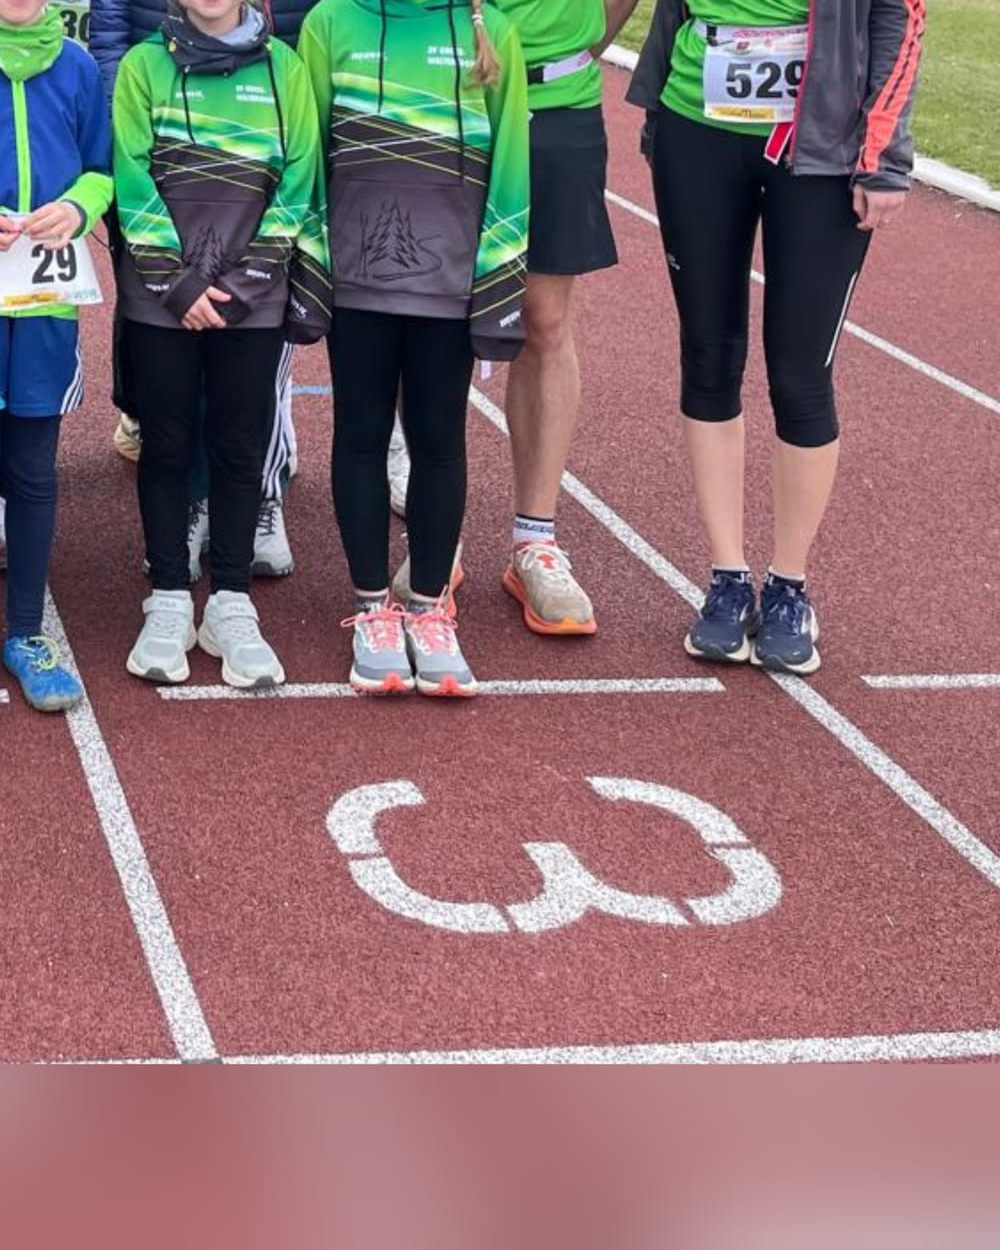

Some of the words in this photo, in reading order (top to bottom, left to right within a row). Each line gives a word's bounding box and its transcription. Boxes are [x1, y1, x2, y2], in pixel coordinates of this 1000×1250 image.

[725, 59, 806, 99] 529
[31, 241, 78, 284] 29
[326, 777, 783, 935] 3
